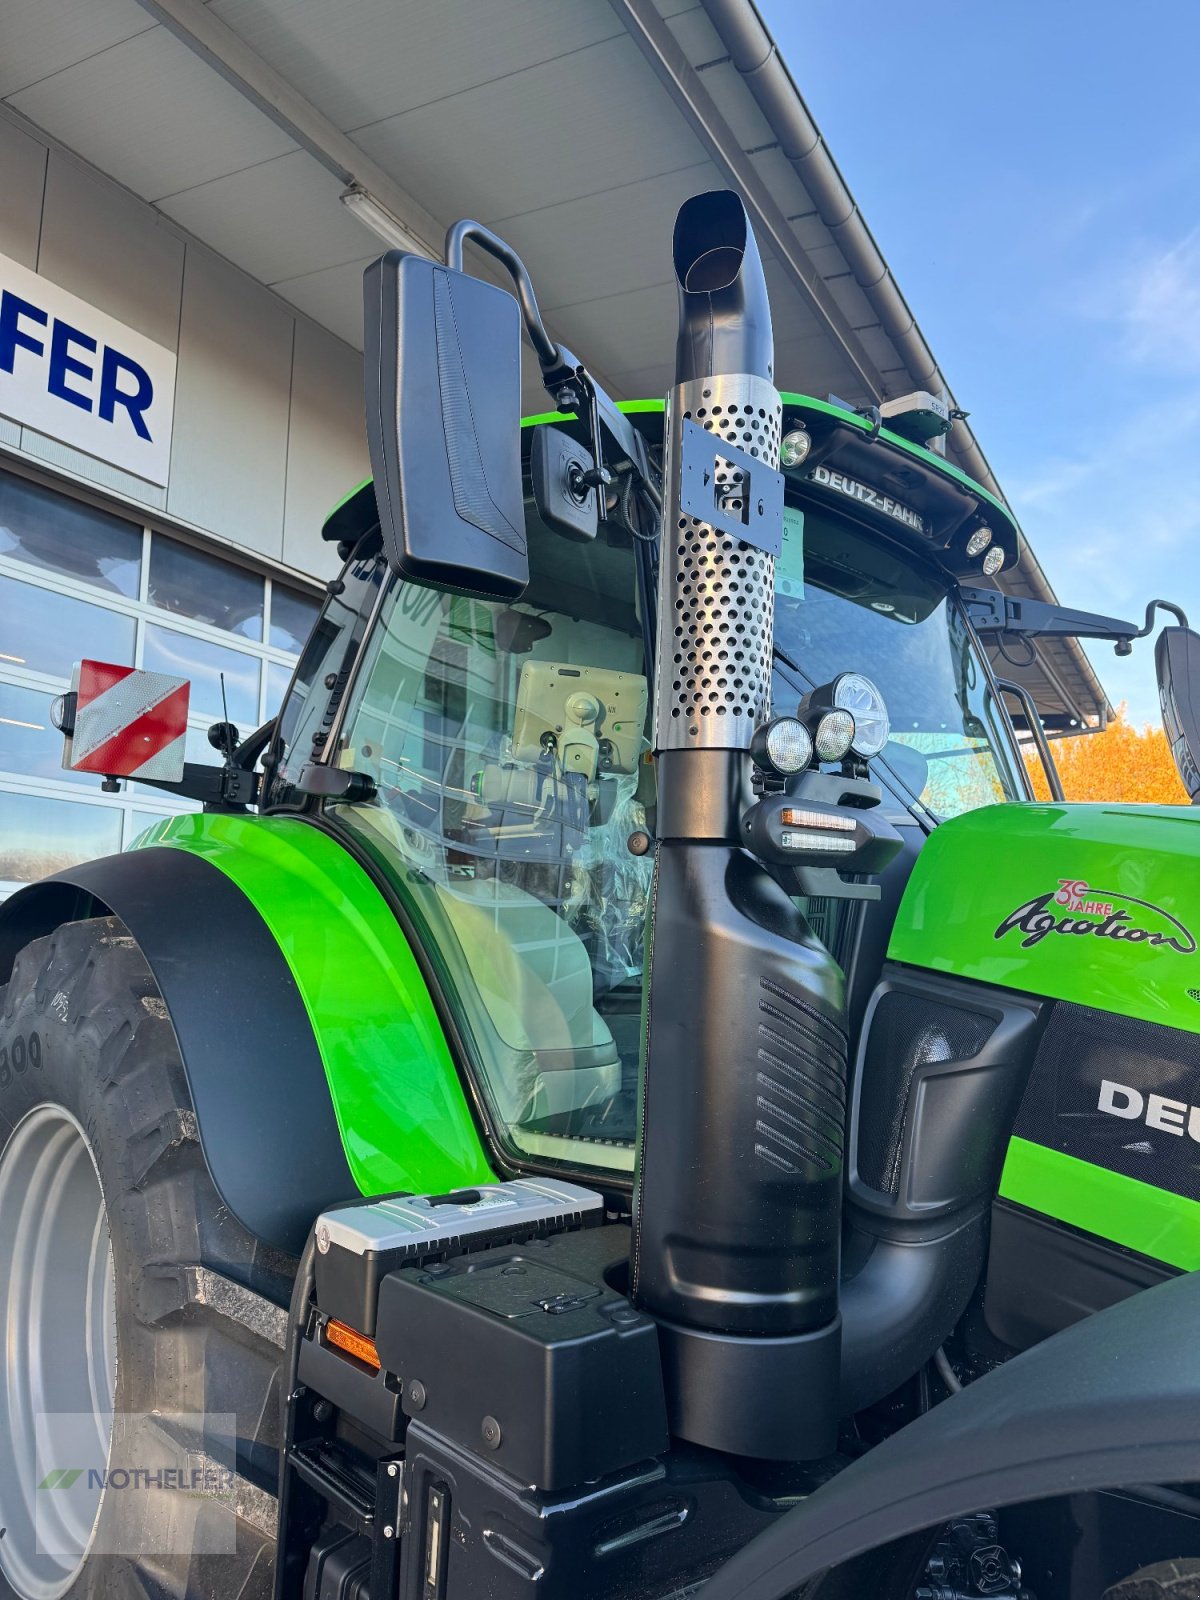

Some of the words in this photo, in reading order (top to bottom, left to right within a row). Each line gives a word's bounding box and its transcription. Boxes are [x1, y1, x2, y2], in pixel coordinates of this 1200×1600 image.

[0, 288, 153, 443] FER
[814, 465, 924, 532] DEUTZ-FAHR
[994, 891, 1196, 954] Agrotron
[1055, 879, 1089, 905] 30
[1067, 901, 1113, 917] JAHRE
[1097, 1079, 1200, 1143] DE
